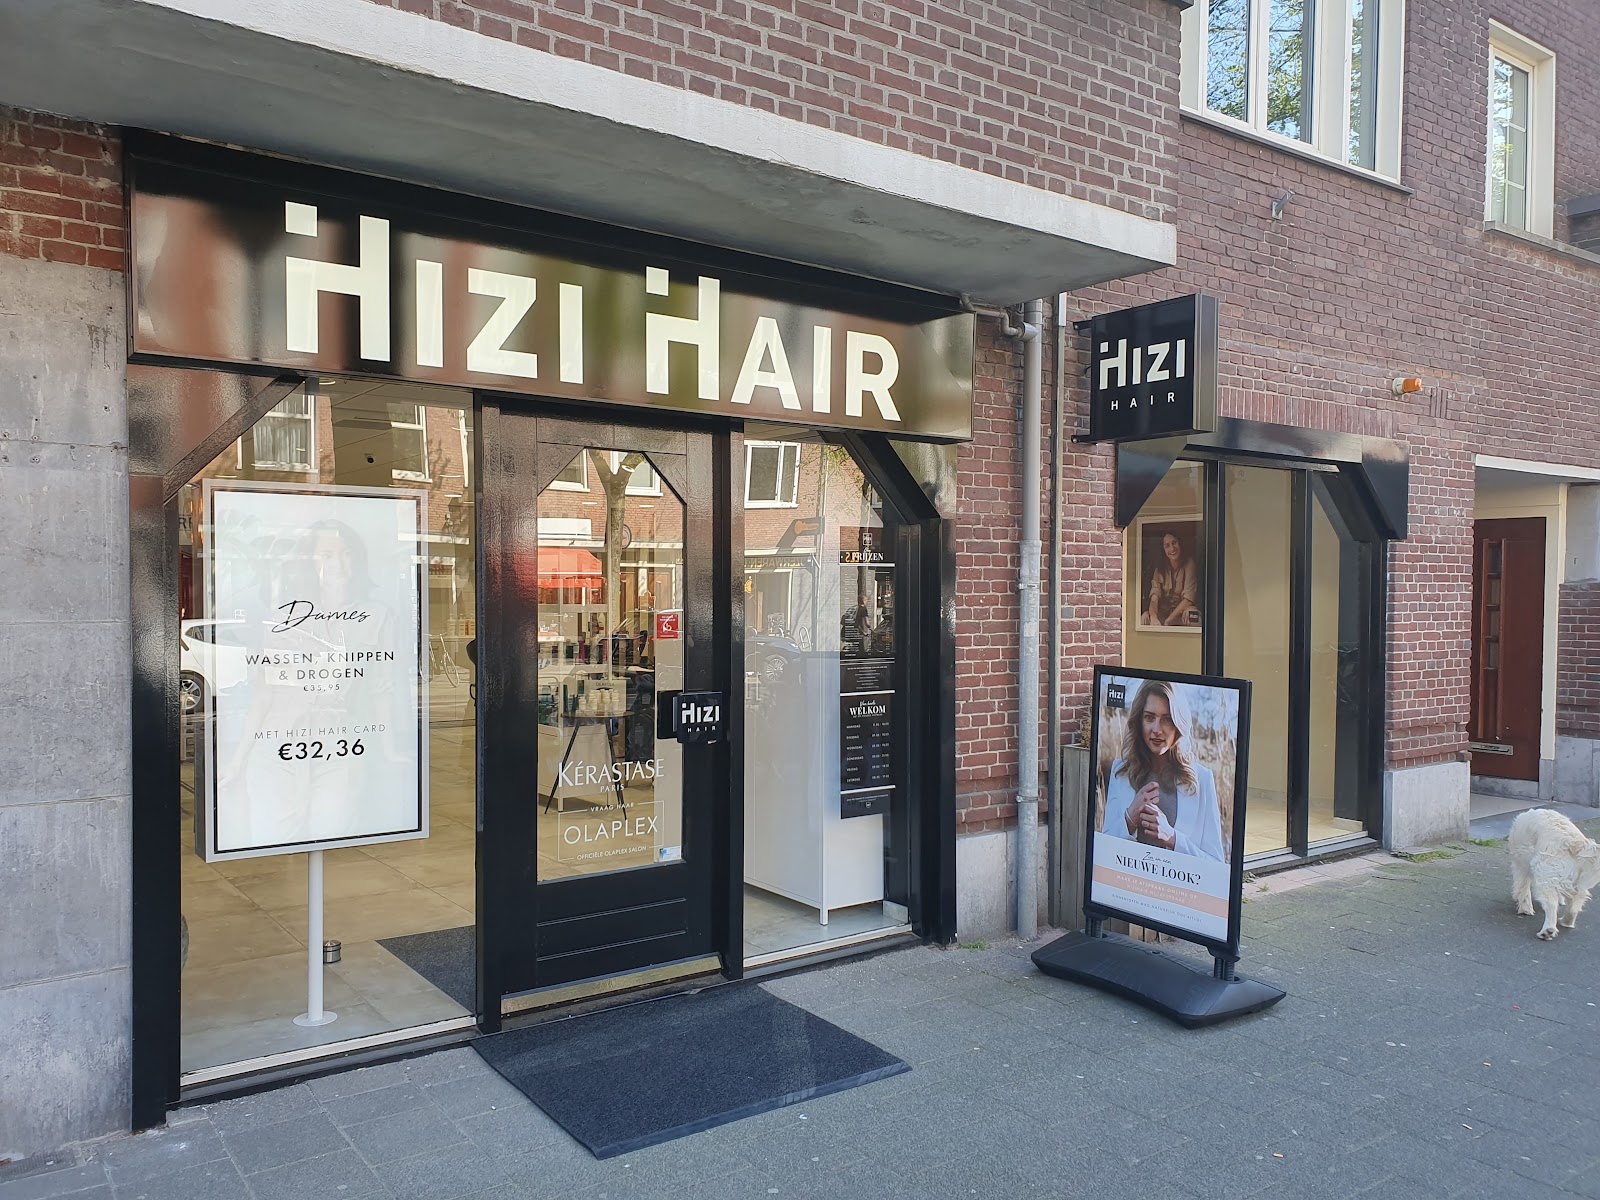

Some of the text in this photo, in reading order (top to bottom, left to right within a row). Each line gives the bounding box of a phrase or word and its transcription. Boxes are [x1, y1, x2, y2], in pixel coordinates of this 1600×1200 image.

[285, 201, 902, 422] HIZI HAIR
[1099, 339, 1186, 390] HIZI
[1111, 392, 1175, 410] HAIR
[271, 600, 371, 633] Dames
[245, 651, 394, 665] WASSEN, KNIPPEN
[279, 667, 364, 681] & DROGEN
[303, 684, 340, 692] €35,95
[681, 702, 720, 724] HIZI
[849, 705, 886, 716] WELKOM
[254, 724, 386, 739] MET HIZI HAIR CARD
[687, 725, 716, 733] HAIR
[278, 738, 365, 761] €32,36
[558, 759, 665, 788] KÉRASTASE
[600, 783, 625, 793] PARIS
[590, 804, 614, 812] VRAAG
[563, 815, 658, 845] OLAPLEX
[604, 848, 628, 857] OLAPLEX
[628, 845, 647, 854] SALON
[1116, 854, 1201, 885] NIEUWE LOOK?
